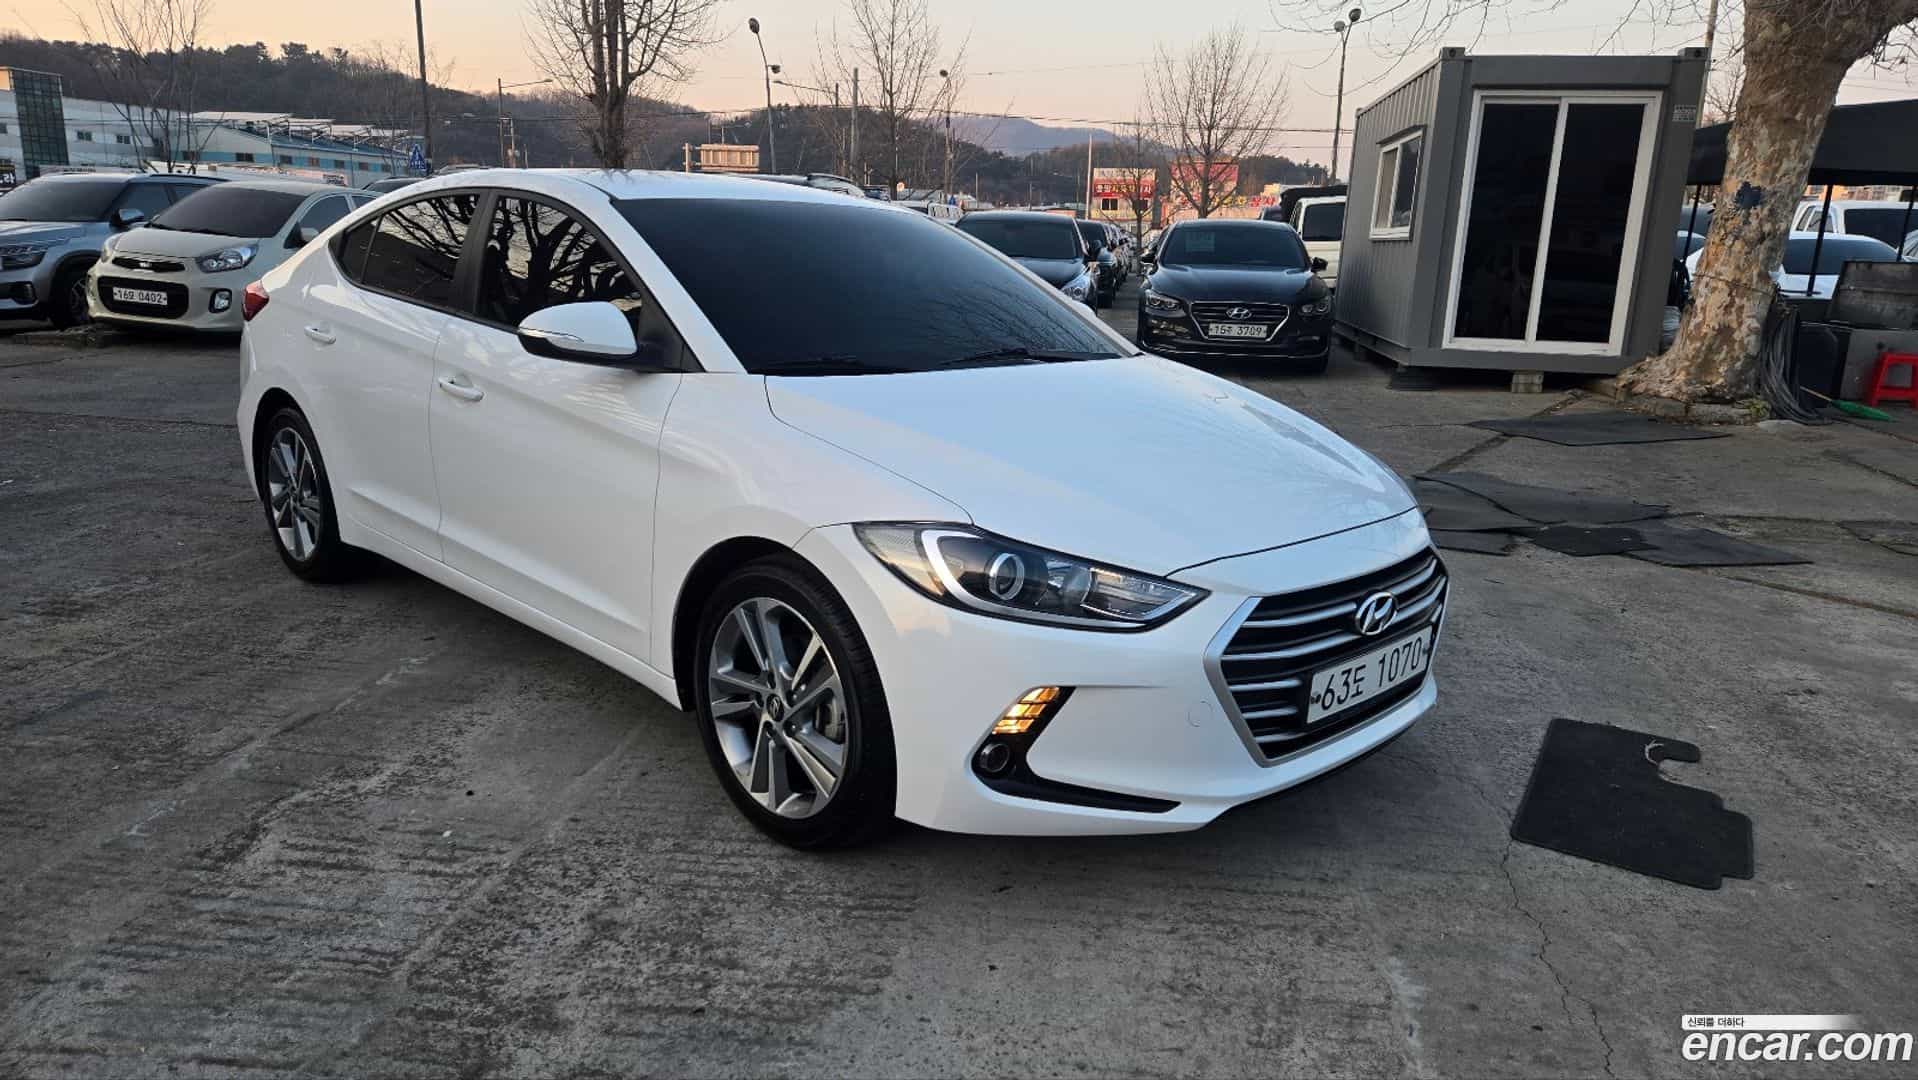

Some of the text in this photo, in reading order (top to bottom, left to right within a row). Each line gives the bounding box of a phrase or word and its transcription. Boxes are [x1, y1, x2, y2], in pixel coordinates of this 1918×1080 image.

[138, 291, 163, 303] 0402
[1236, 326, 1262, 337] 3709
[1321, 636, 1422, 710] 63도 1070
